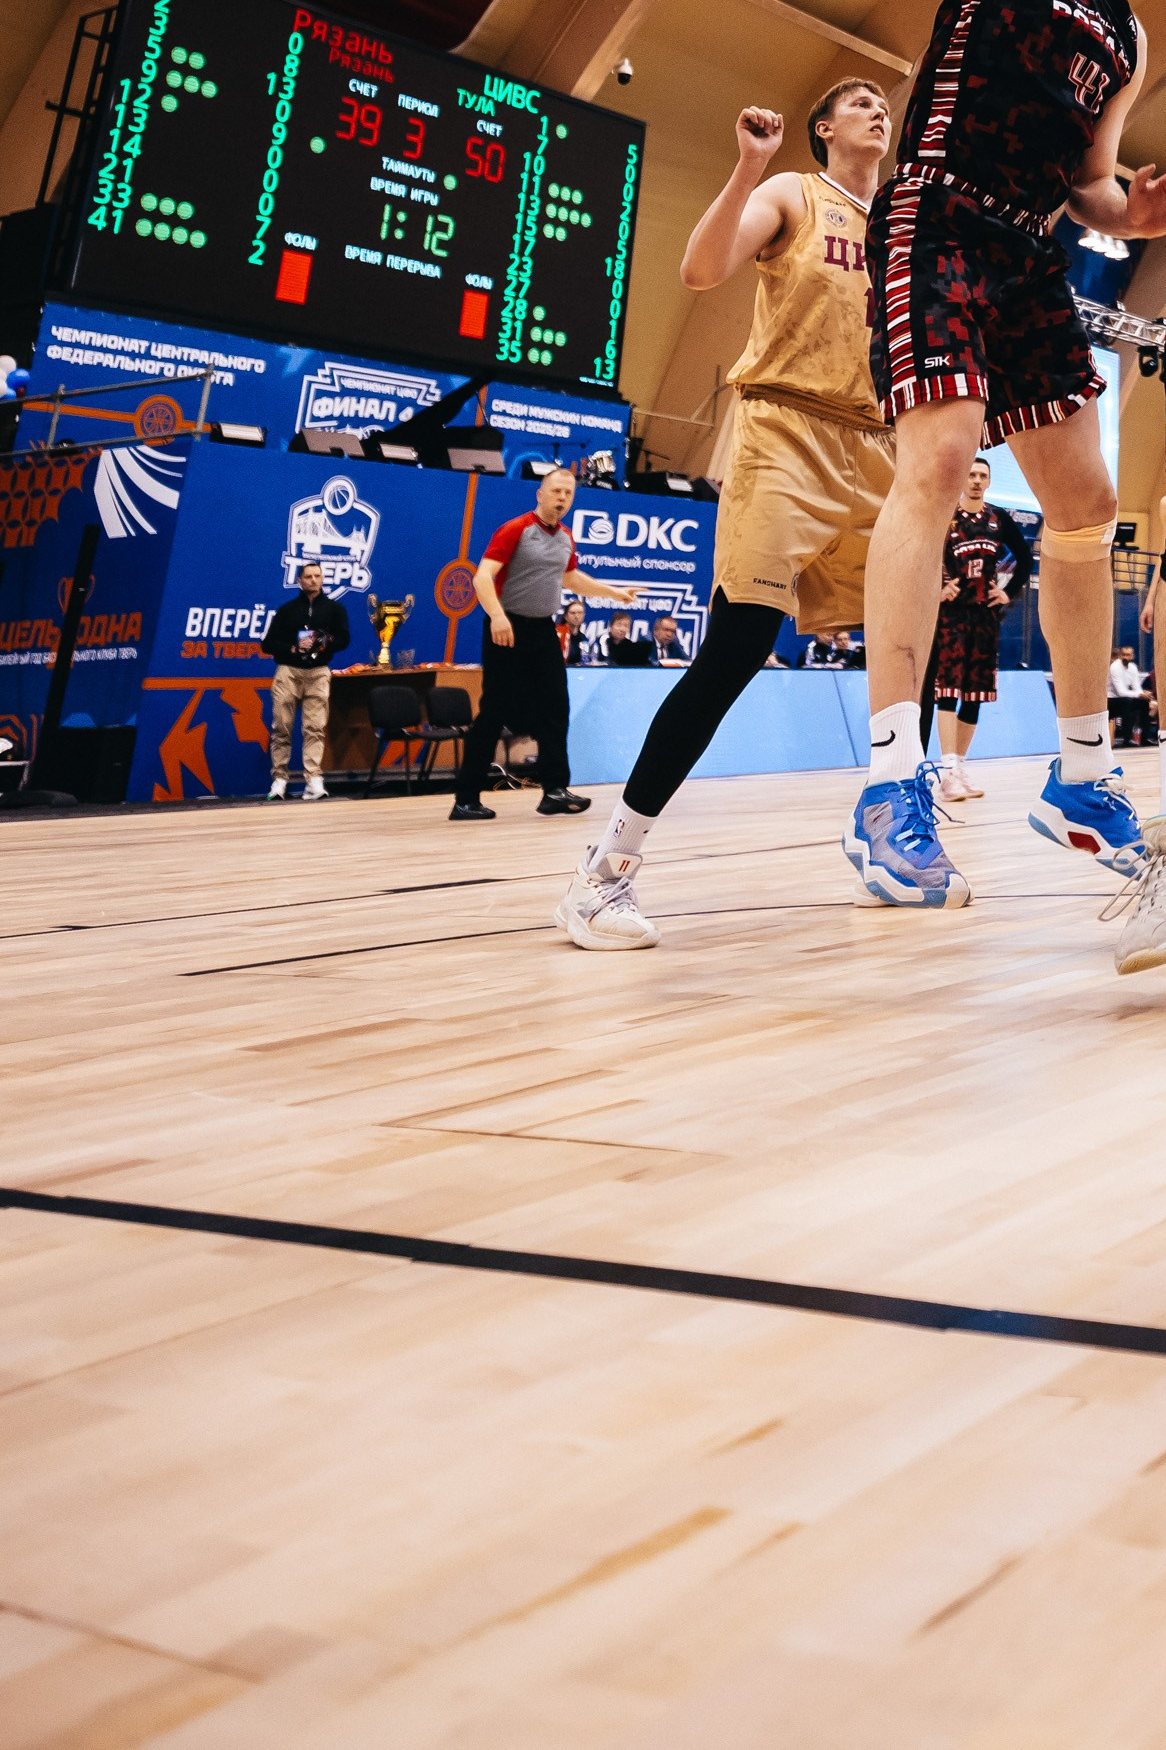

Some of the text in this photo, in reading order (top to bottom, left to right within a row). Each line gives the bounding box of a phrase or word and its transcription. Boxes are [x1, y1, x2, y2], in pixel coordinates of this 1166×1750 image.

[149, 11, 167, 35] 3
[144, 35, 162, 60] 5
[288, 31, 305, 55] 0
[293, 8, 394, 65] Рязань
[141, 59, 158, 83] 9
[283, 53, 301, 78] 8
[328, 45, 395, 83] Рязань
[120, 78, 152, 110] 12
[266, 72, 297, 101] 13
[348, 78, 379, 99] СЧЕТ
[483, 73, 543, 114] ЦИВС
[275, 100, 292, 123] 0
[397, 93, 440, 118] ПЕРИОД
[456, 88, 496, 117] ТУЛА
[115, 103, 148, 133] 13
[335, 96, 383, 147] 39
[476, 119, 503, 137] СЧЕТ
[540, 115, 549, 137] 1
[109, 128, 142, 159] 14
[271, 123, 288, 146] 9
[402, 117, 425, 160] 3
[536, 134, 550, 156] 7
[267, 145, 284, 170] 0
[465, 136, 506, 183] 50
[523, 151, 546, 176] 10
[626, 144, 638, 165] 5
[98, 153, 134, 184] 21
[262, 168, 279, 193] 0
[381, 156, 437, 184] ТАЙМАУТЫ
[624, 163, 637, 184] 0
[93, 178, 132, 209] 33
[370, 176, 440, 206] ВРЕМЯ ИГРЫ
[519, 171, 541, 196] 11
[622, 182, 634, 203] 0
[258, 192, 275, 217] 0
[517, 191, 541, 217] 13
[619, 201, 632, 223] 2
[87, 205, 124, 235] 41
[255, 214, 272, 239] 7
[379, 202, 456, 258] 1:12
[514, 212, 539, 237] 15
[617, 221, 630, 242] 0
[247, 239, 266, 266] 2
[284, 231, 318, 251] ФОЛЫ
[511, 233, 537, 257] 17
[615, 240, 627, 261] 5
[344, 244, 443, 279] ВРЕМЯ ПЕРЕРЫВА
[506, 253, 533, 278] 23
[604, 257, 626, 280] 18
[464, 273, 494, 290] ФОЛЫ
[503, 275, 531, 299] 27
[611, 279, 623, 300] 0
[500, 296, 528, 321] 28
[608, 299, 621, 320] 0
[498, 317, 524, 342] 31
[608, 319, 617, 340] 1
[46, 345, 175, 377] ФЕДЕРАЛЬНОГО
[51, 325, 266, 374] ЧЕМПИОНАТ ЦЕНТРАЛЬНОГО
[495, 339, 522, 364] 35
[604, 339, 616, 360] 6
[924, 355, 950, 369] STK
[593, 357, 615, 380] 13
[341, 377, 396, 396] ЧЕМПИОНАТ
[312, 396, 397, 423] ФИНАЛ
[616, 513, 699, 552] DKC
[285, 556, 370, 588] ТЕРЬ
[642, 559, 696, 574] спонсор
[967, 558, 984, 579] 12
[181, 641, 208, 659] ЗА
